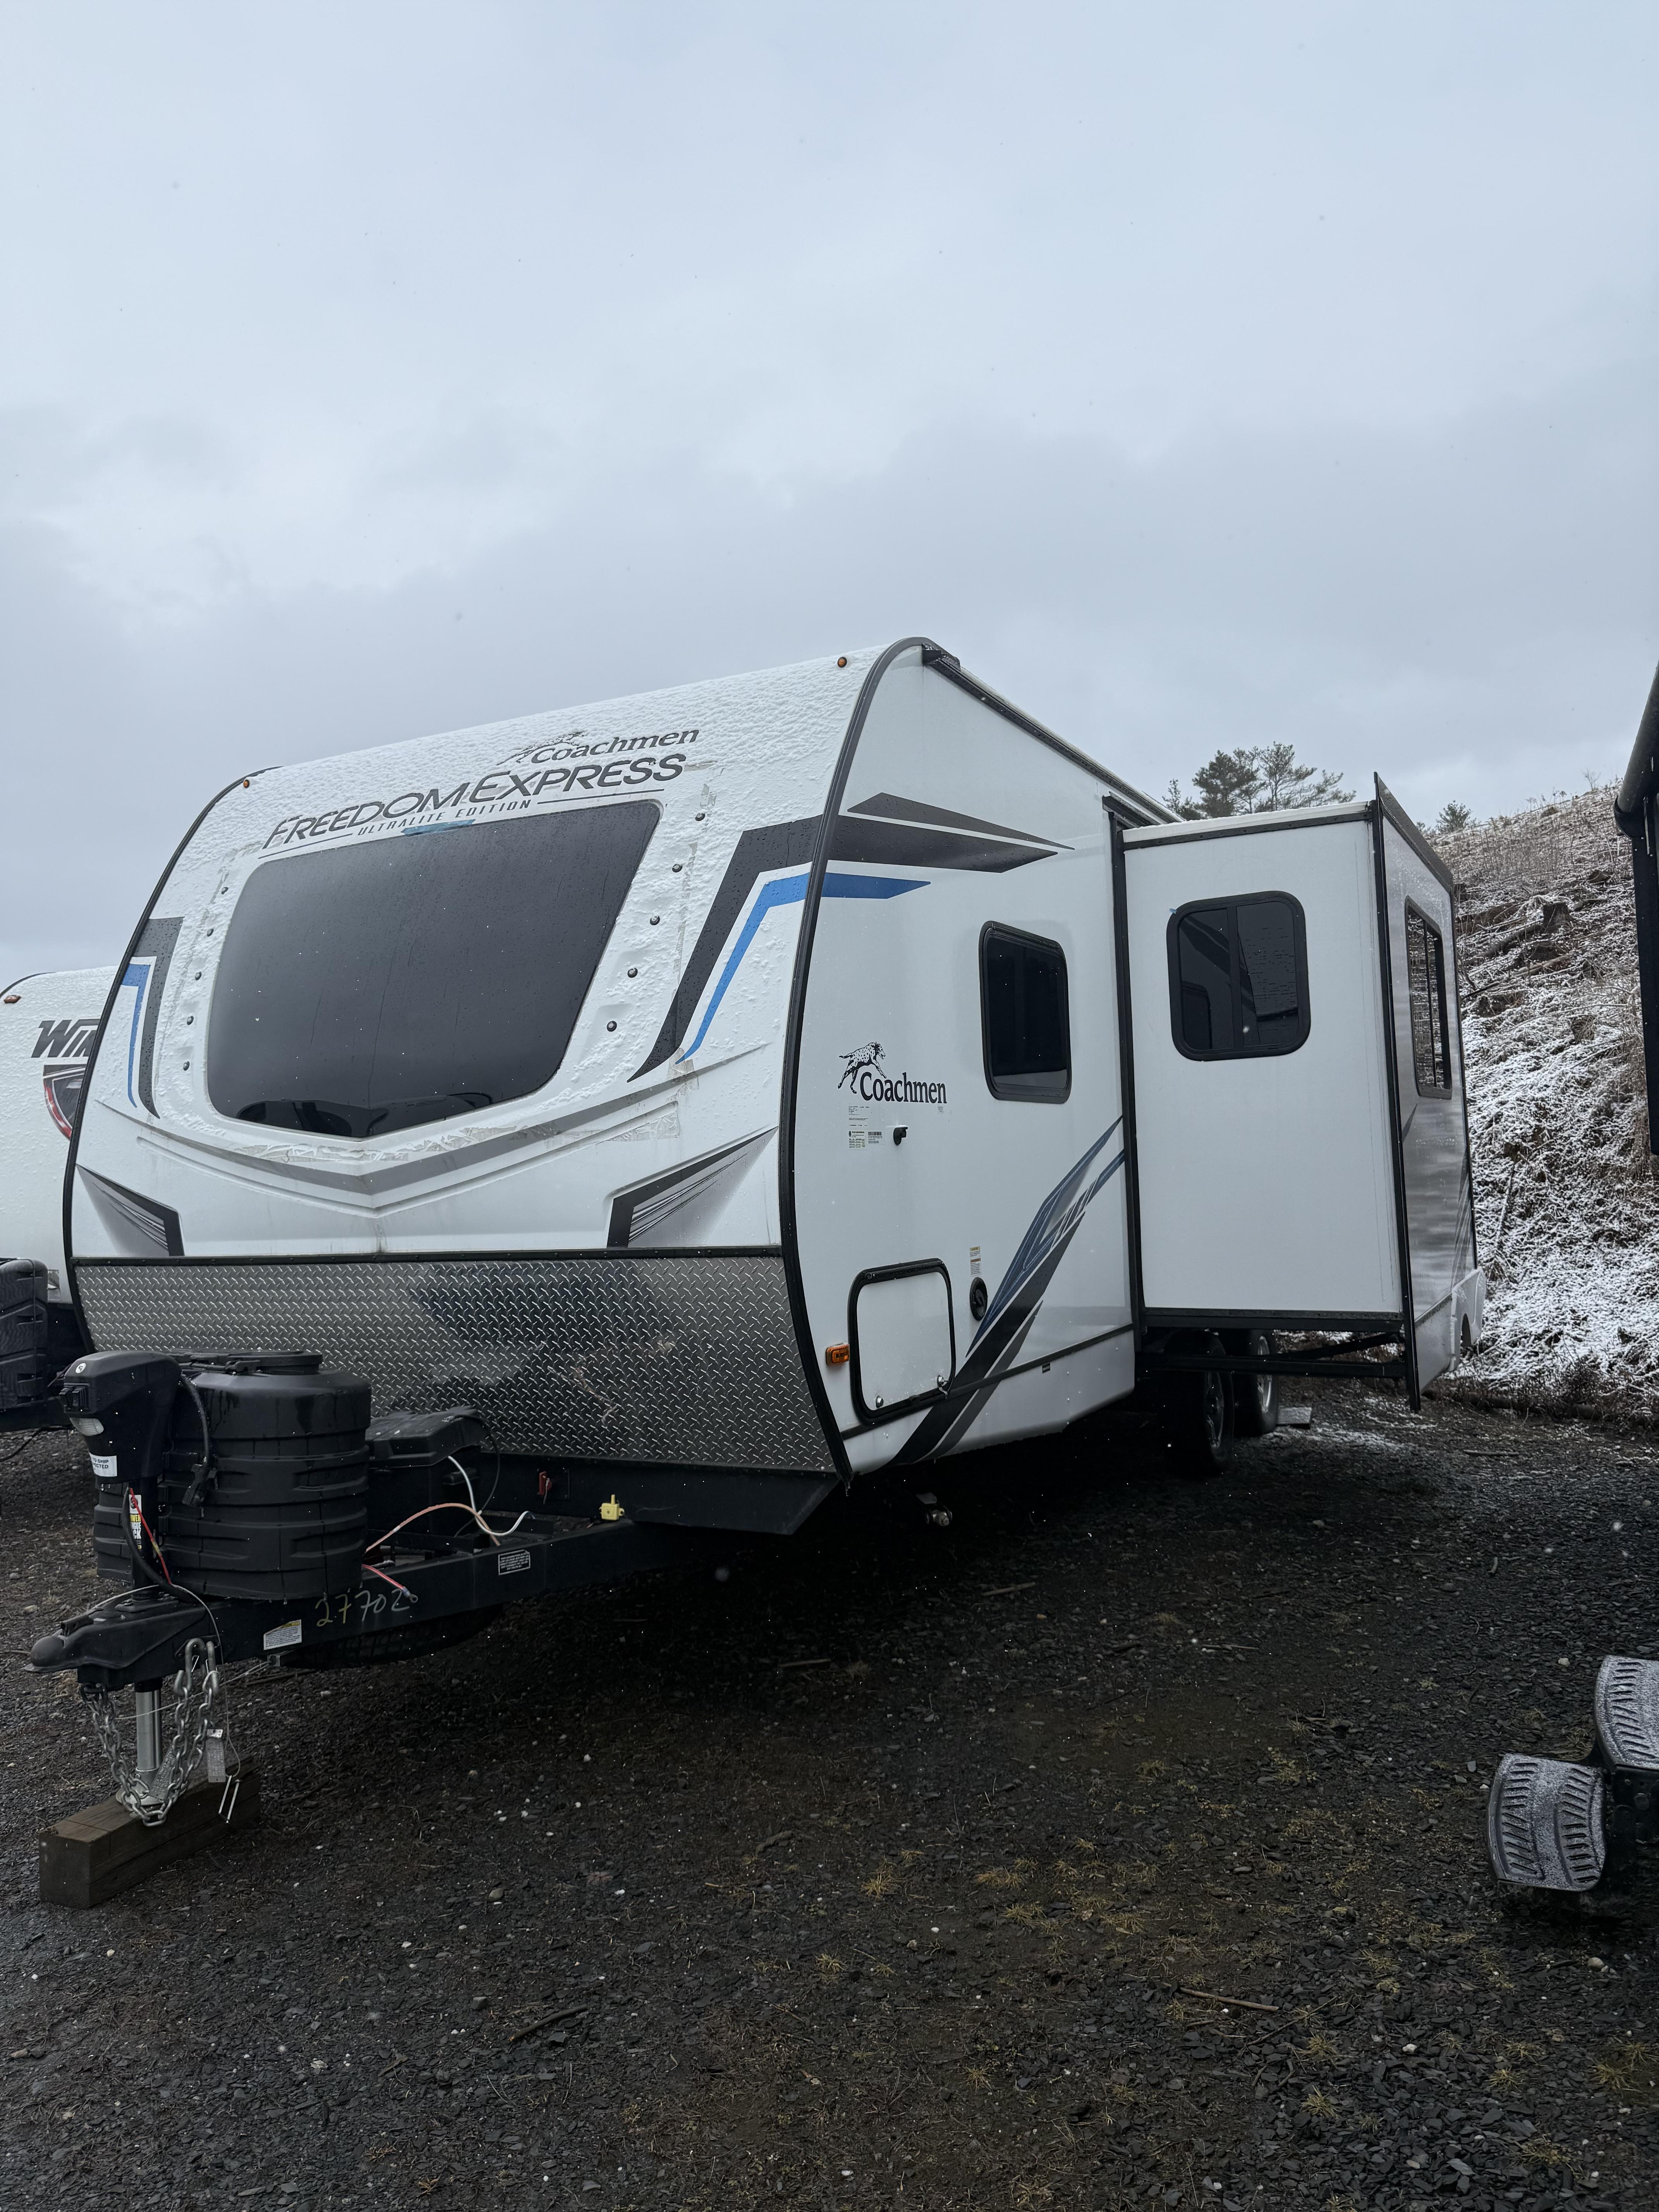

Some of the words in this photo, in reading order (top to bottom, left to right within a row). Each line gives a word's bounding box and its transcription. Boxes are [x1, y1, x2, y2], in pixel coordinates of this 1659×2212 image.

[531, 730, 699, 764] Coachmen
[357, 812, 446, 836] ULTRALITE
[455, 800, 531, 818] EDITION
[860, 1072, 947, 1104] Coachmen
[315, 1589, 410, 1626] 27702
